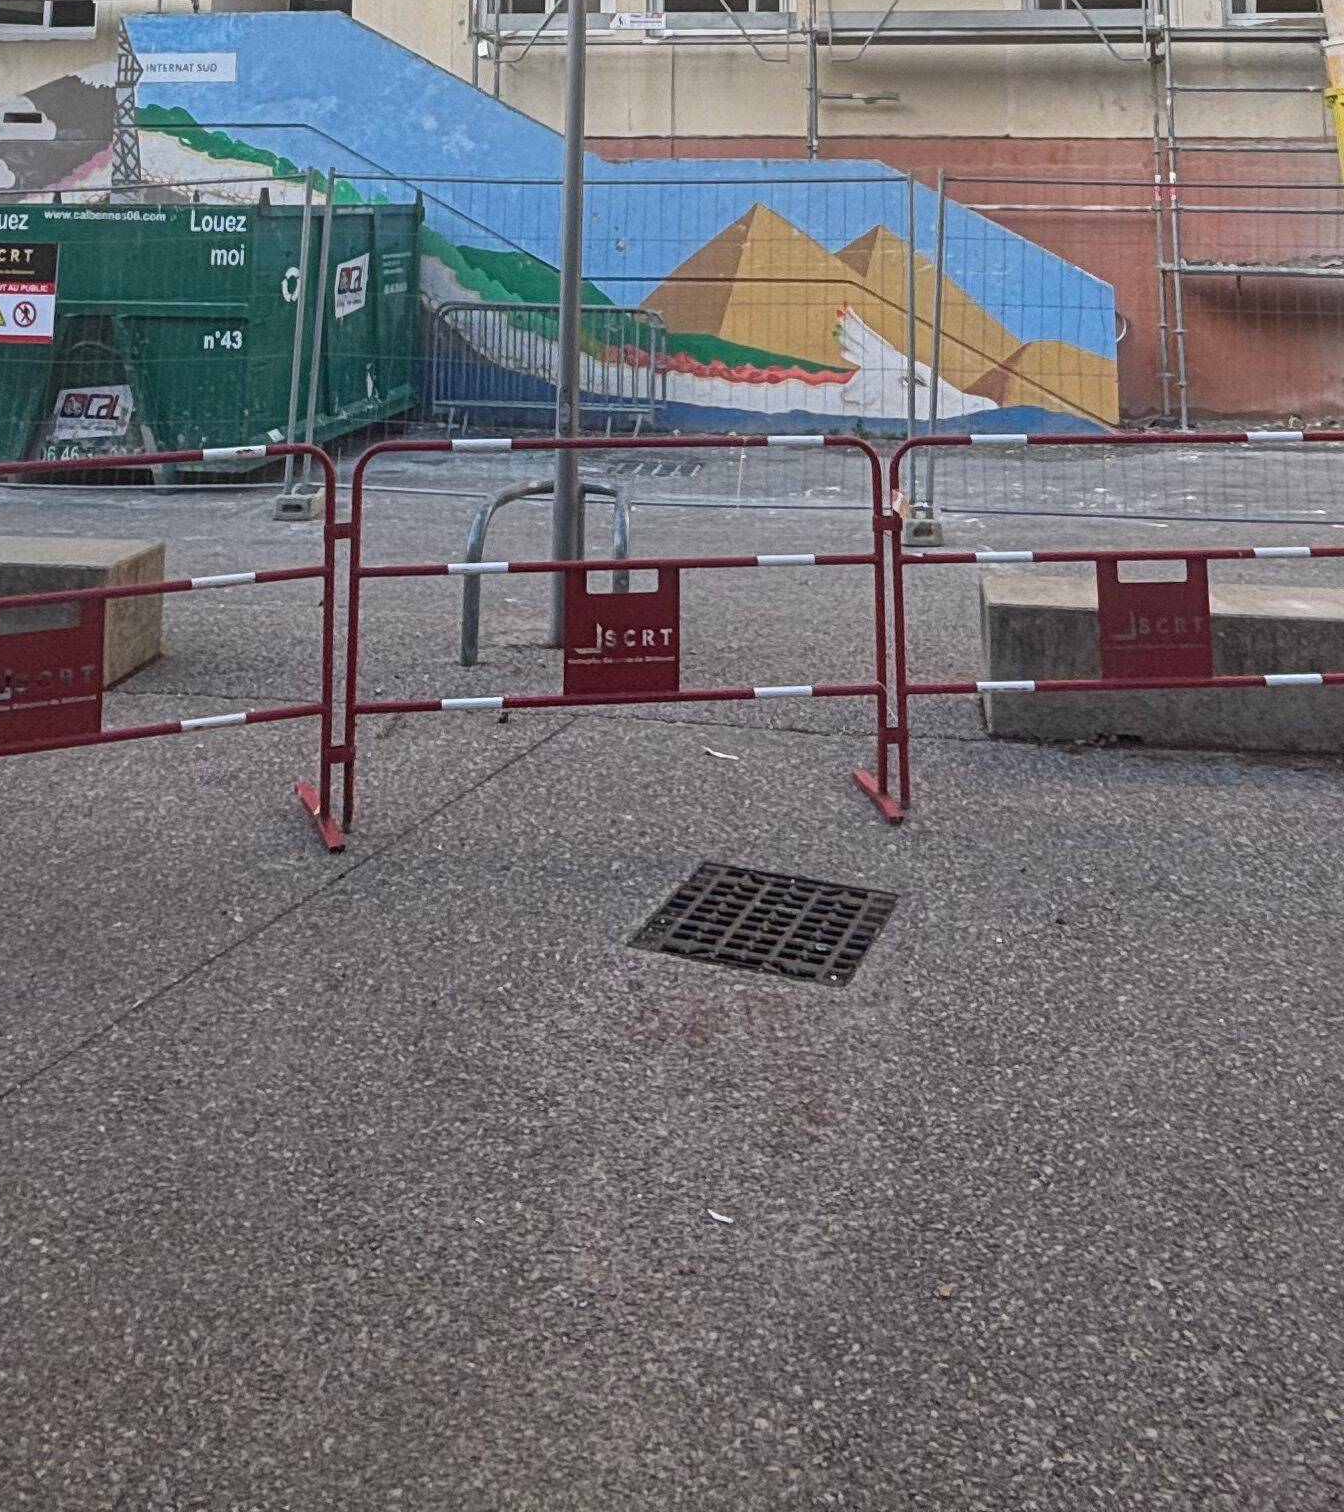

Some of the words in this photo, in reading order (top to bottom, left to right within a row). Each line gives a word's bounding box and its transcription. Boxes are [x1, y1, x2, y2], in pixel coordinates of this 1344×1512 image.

[146, 63, 194, 73] INTERNAT
[196, 63, 218, 73] SUD
[190, 209, 247, 232] Louez
[210, 243, 245, 266] moi
[7, 284, 19, 292] AU
[19, 284, 49, 293] PUBLIC
